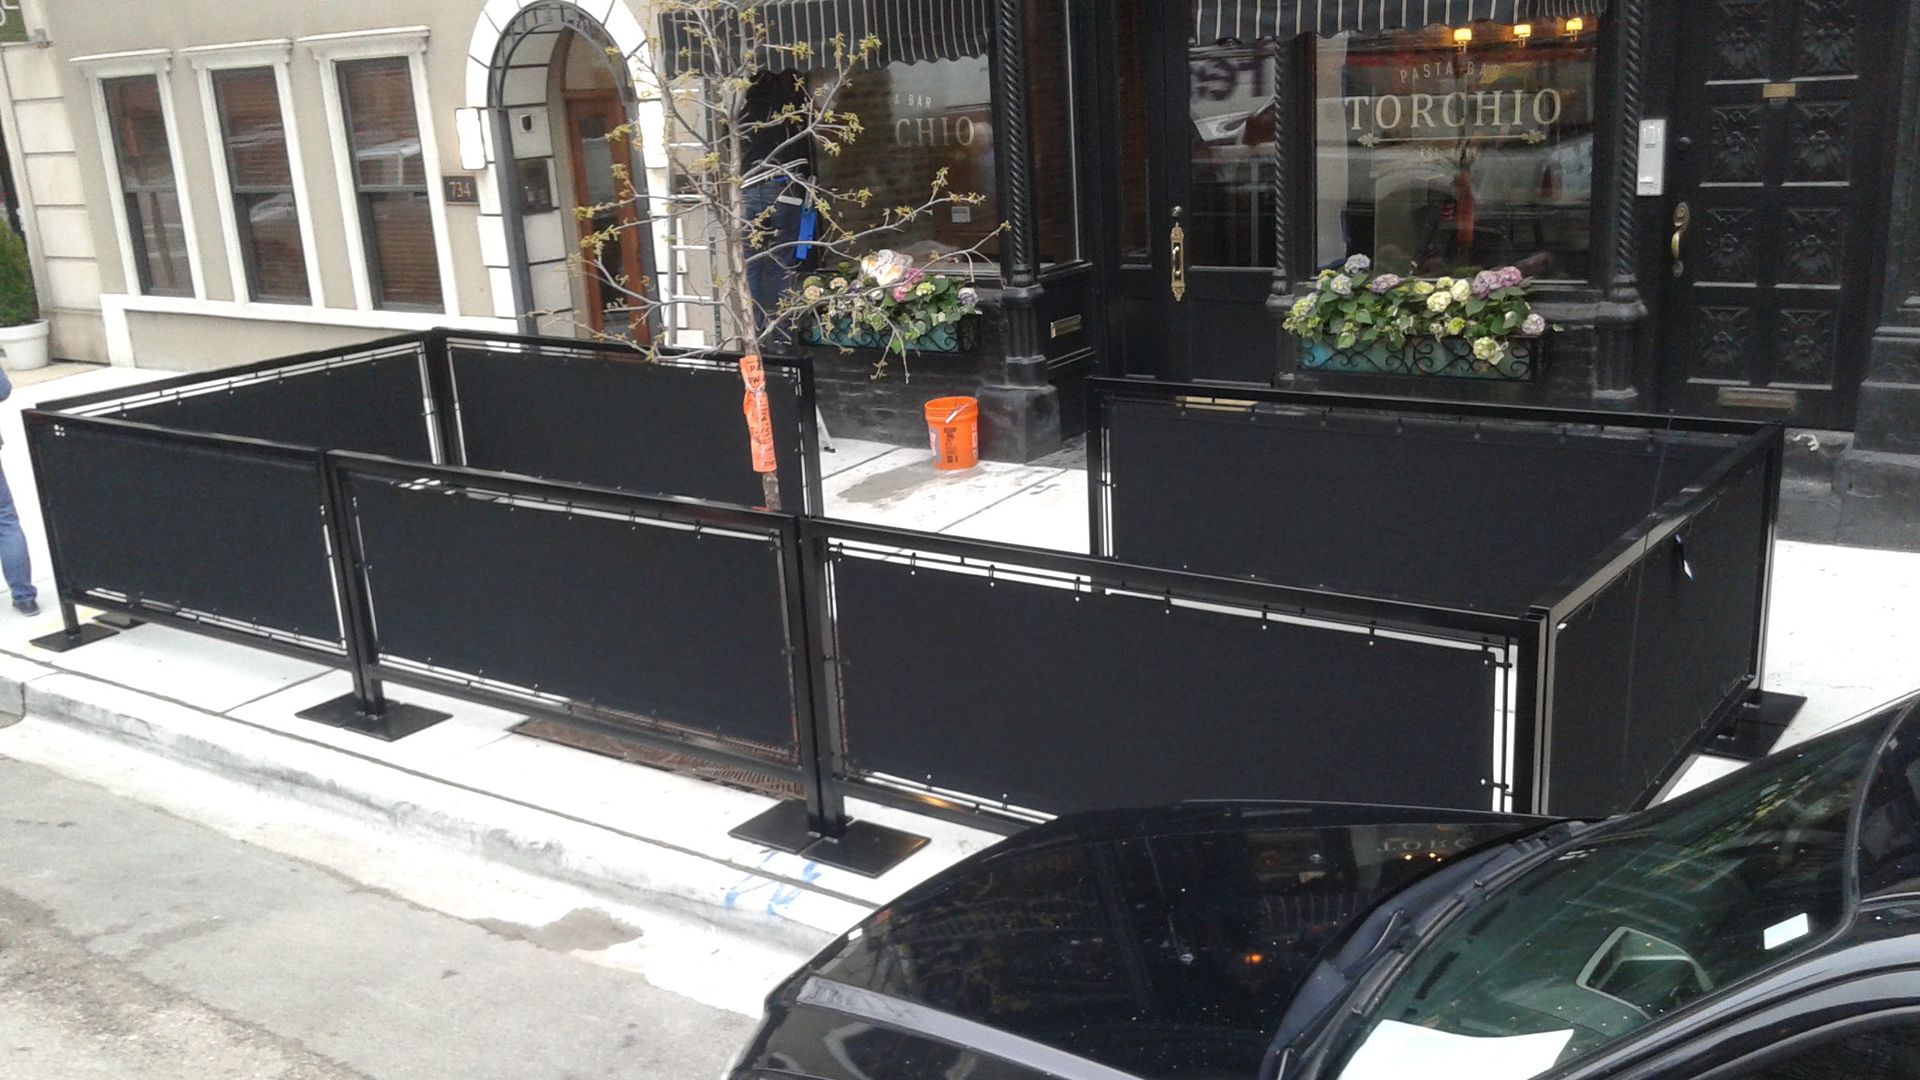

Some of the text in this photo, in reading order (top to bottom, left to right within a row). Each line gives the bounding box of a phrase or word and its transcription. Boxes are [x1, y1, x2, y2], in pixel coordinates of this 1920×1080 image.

[1400, 62, 1453, 84] PASTA
[908, 93, 932, 109] BAR
[1344, 88, 1562, 130] TORCHIO
[894, 116, 975, 147] CHIO
[448, 181, 471, 198] 734
